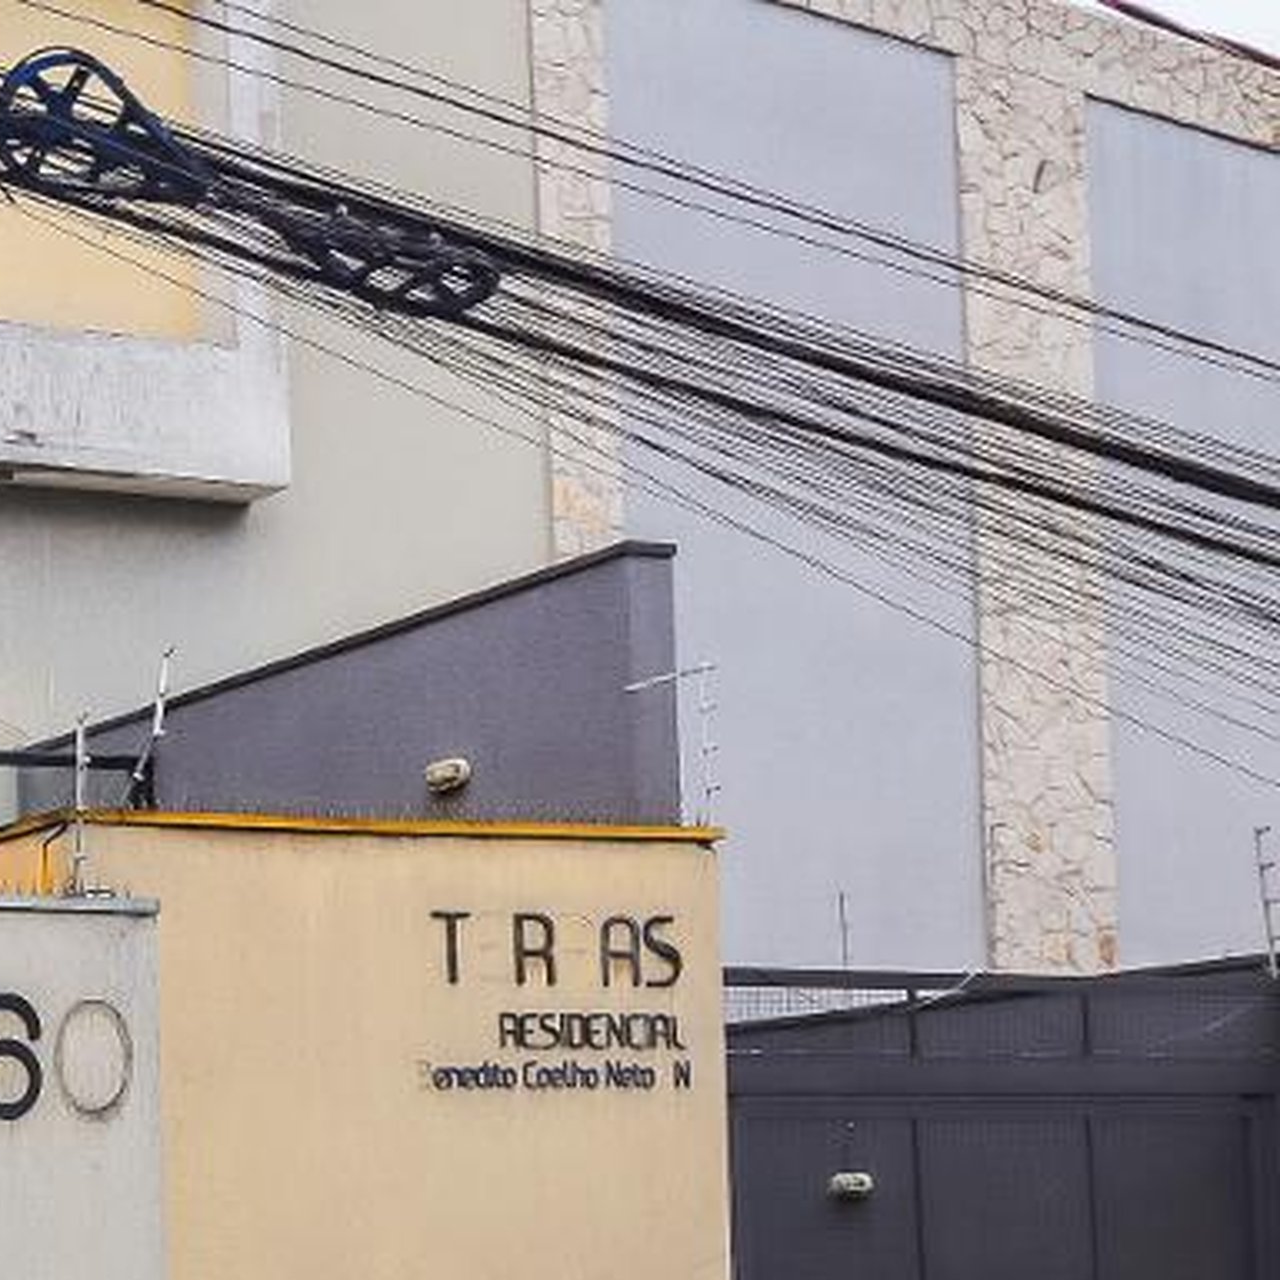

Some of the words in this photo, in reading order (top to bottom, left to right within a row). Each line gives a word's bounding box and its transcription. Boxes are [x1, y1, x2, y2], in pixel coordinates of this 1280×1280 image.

[429, 910, 685, 988] TRAS
[522, 1060, 600, 1090] Coelho
[604, 1059, 656, 1090] Neto
